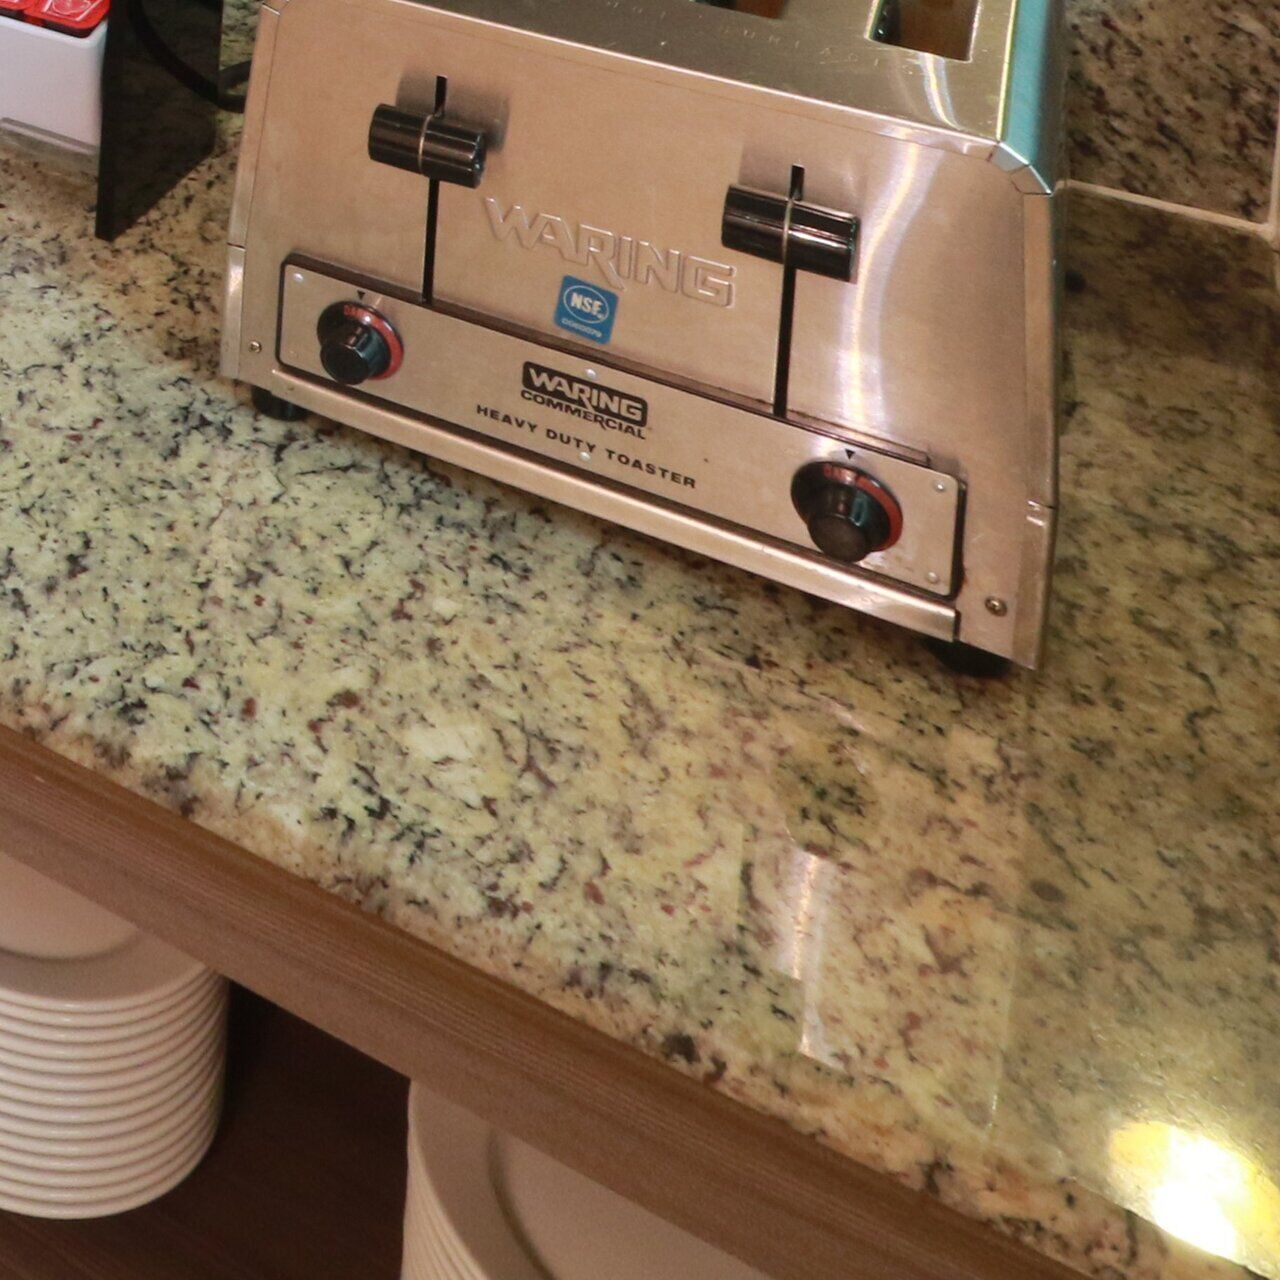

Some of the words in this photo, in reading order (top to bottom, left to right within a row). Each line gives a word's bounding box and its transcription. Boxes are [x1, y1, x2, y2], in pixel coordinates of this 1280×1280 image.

[483, 196, 737, 309] WARING
[570, 292, 604, 315] NSF
[521, 389, 647, 440] COMMERCIAL
[528, 367, 645, 422] WARING
[476, 404, 538, 434] HEAVY
[546, 427, 596, 454] DUTY
[605, 448, 697, 489] TOASTER
